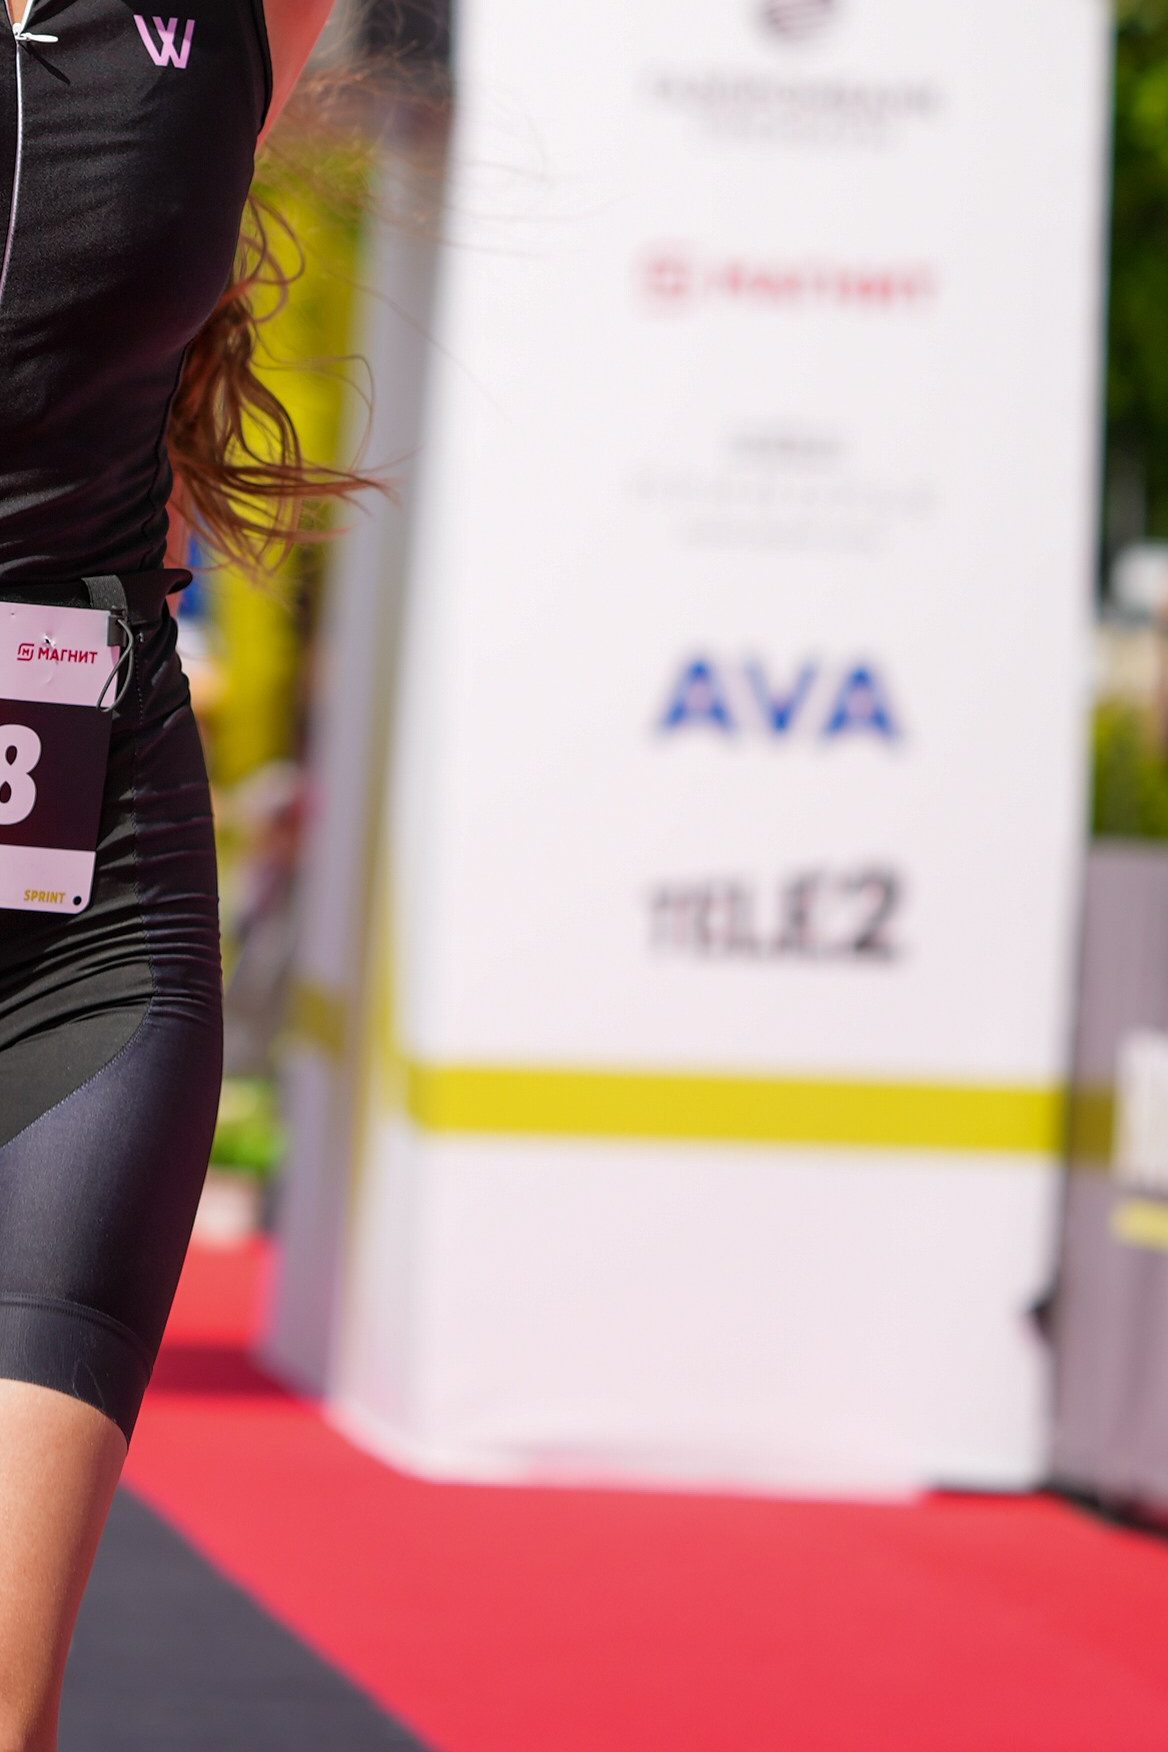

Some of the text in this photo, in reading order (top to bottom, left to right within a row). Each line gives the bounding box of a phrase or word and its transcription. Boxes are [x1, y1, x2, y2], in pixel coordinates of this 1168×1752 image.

[37, 647, 98, 664] МАГНИТ
[655, 652, 904, 747] AVA
[23, 889, 66, 904] SPRINT
